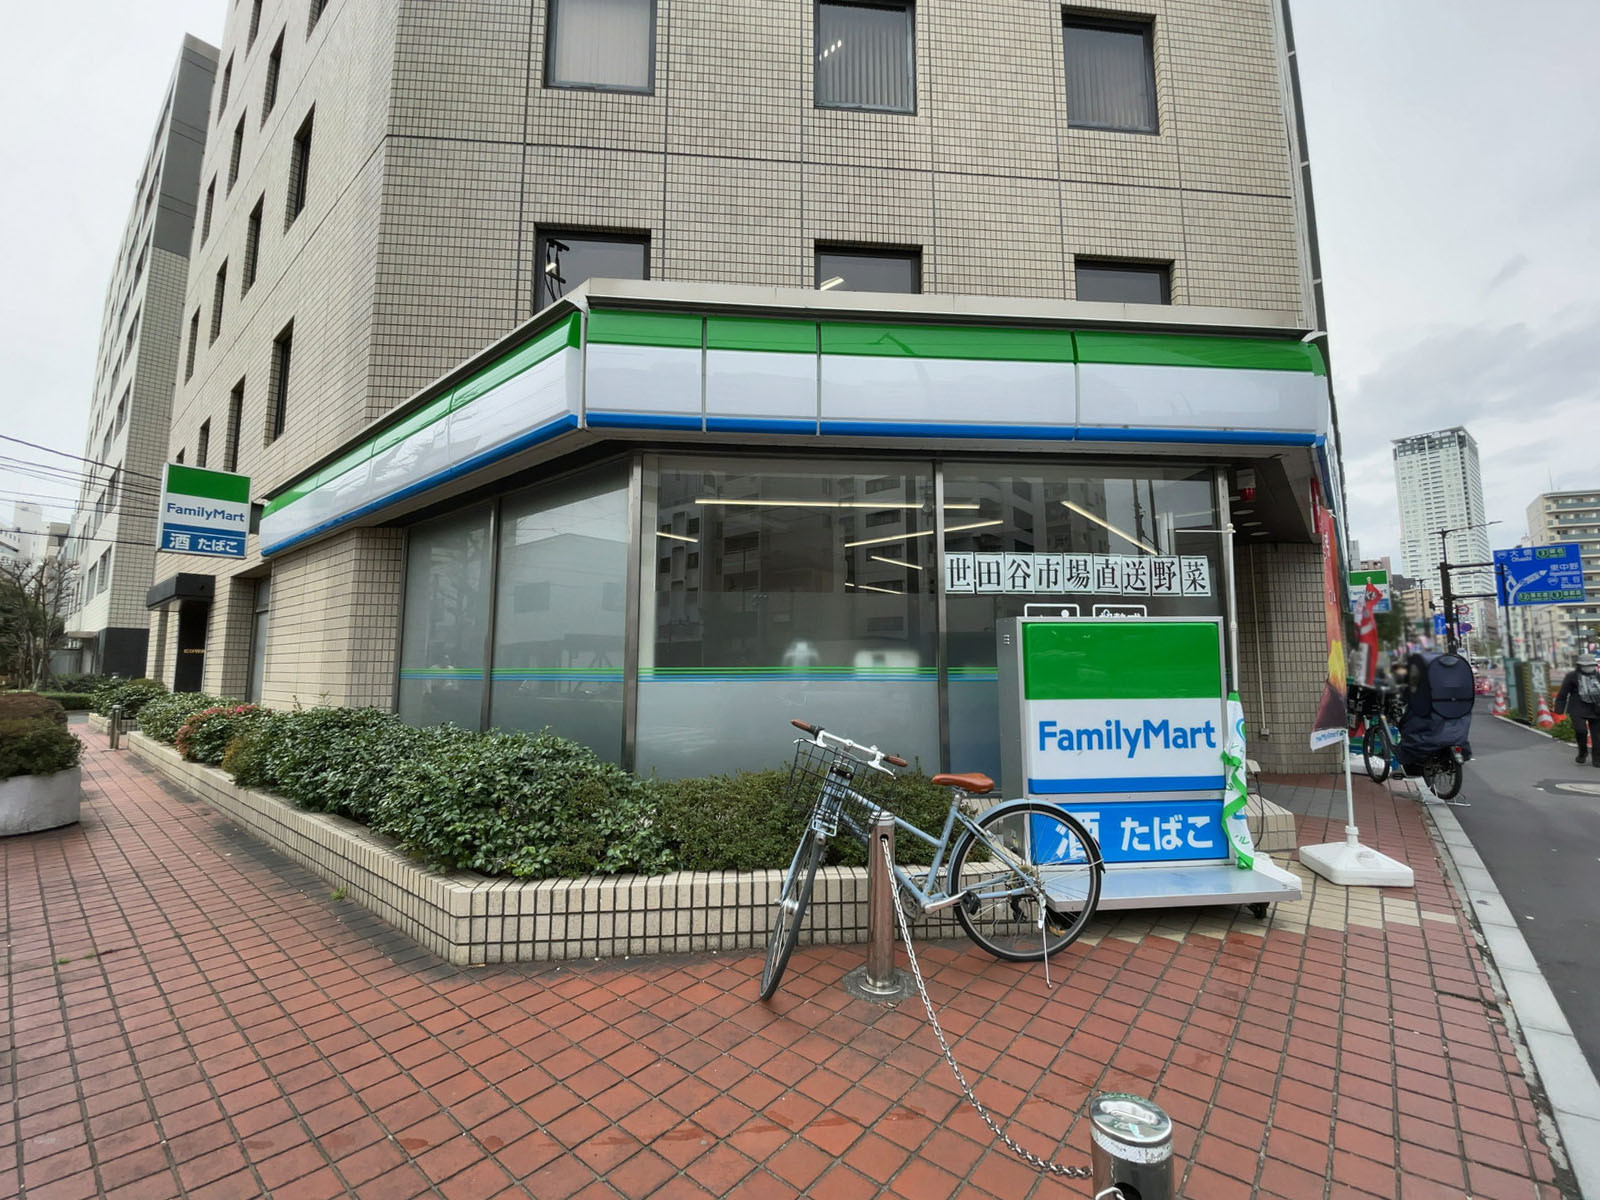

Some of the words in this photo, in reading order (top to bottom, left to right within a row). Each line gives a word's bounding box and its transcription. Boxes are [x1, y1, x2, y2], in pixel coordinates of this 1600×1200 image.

[167, 503, 245, 522] FamilyMart
[169, 532, 192, 551] 酒
[197, 537, 238, 553] たばこ
[947, 557, 1206, 592] 世田谷市場直送野菜
[1038, 719, 1217, 759] FamilyMart
[1120, 814, 1214, 852] たばこ
